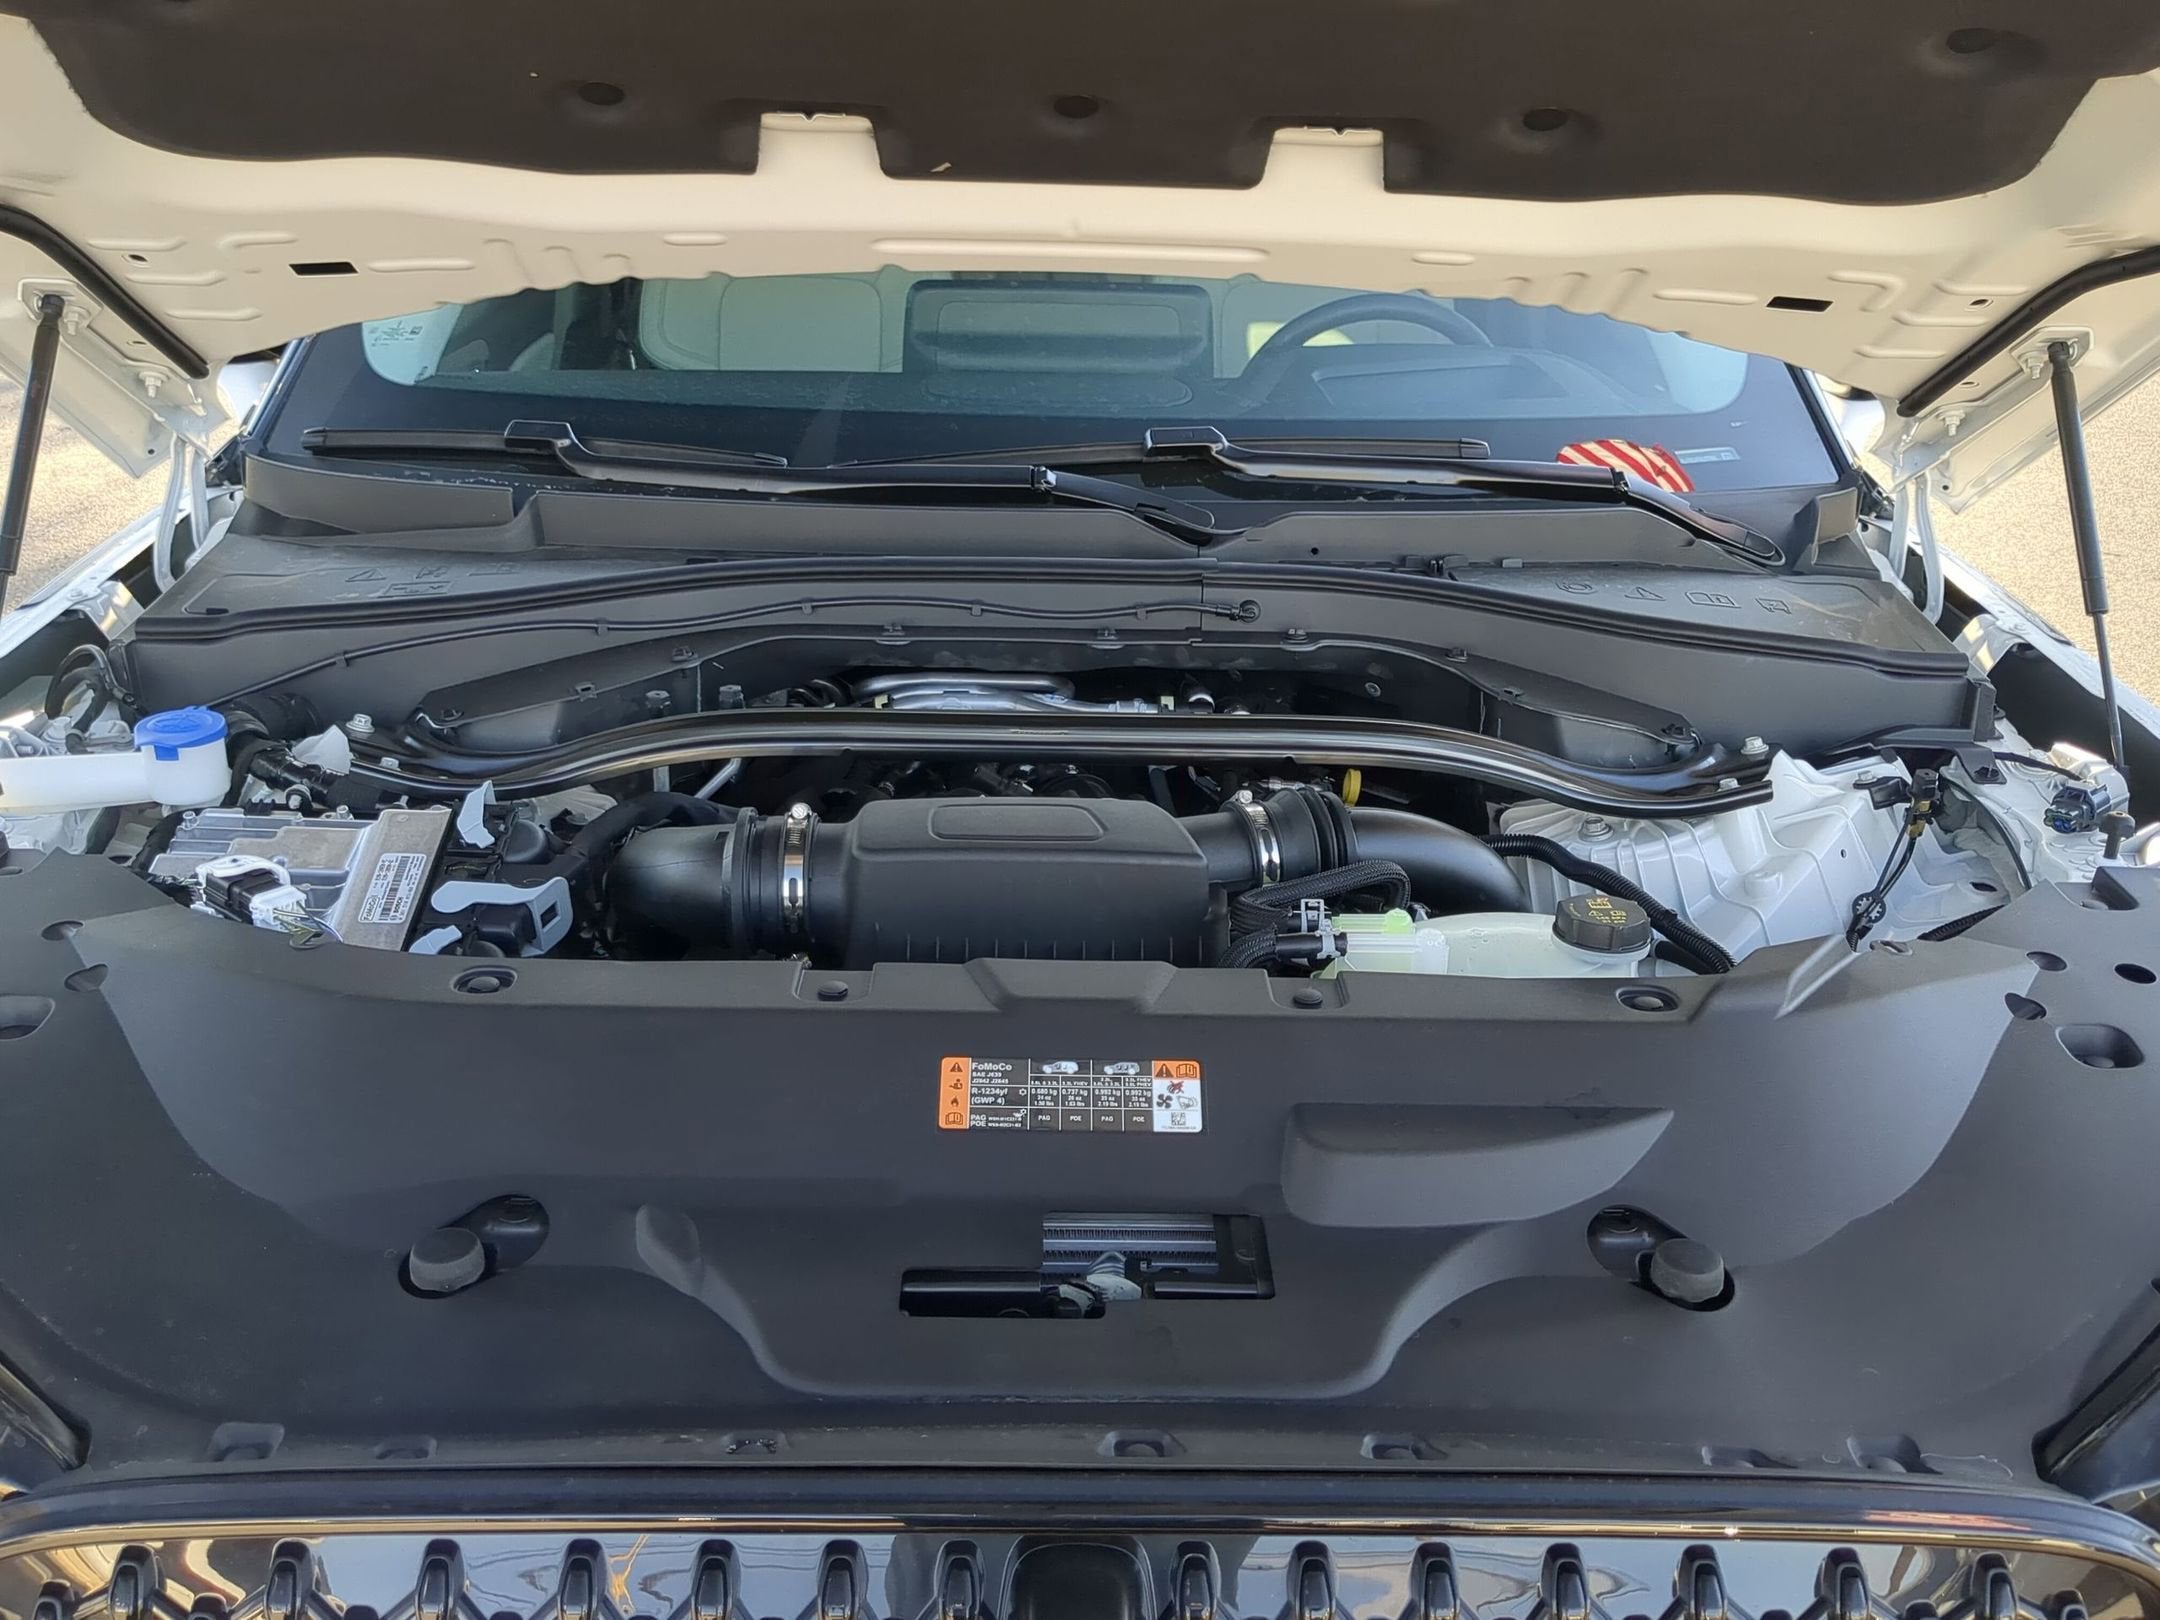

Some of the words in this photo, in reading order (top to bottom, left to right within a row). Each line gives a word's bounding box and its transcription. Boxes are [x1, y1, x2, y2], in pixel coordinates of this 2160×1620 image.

[972, 1062, 1012, 1071] FoMoCo
[972, 1088, 1008, 1096] R-1234yf
[996, 1097, 1005, 1105] 4)
